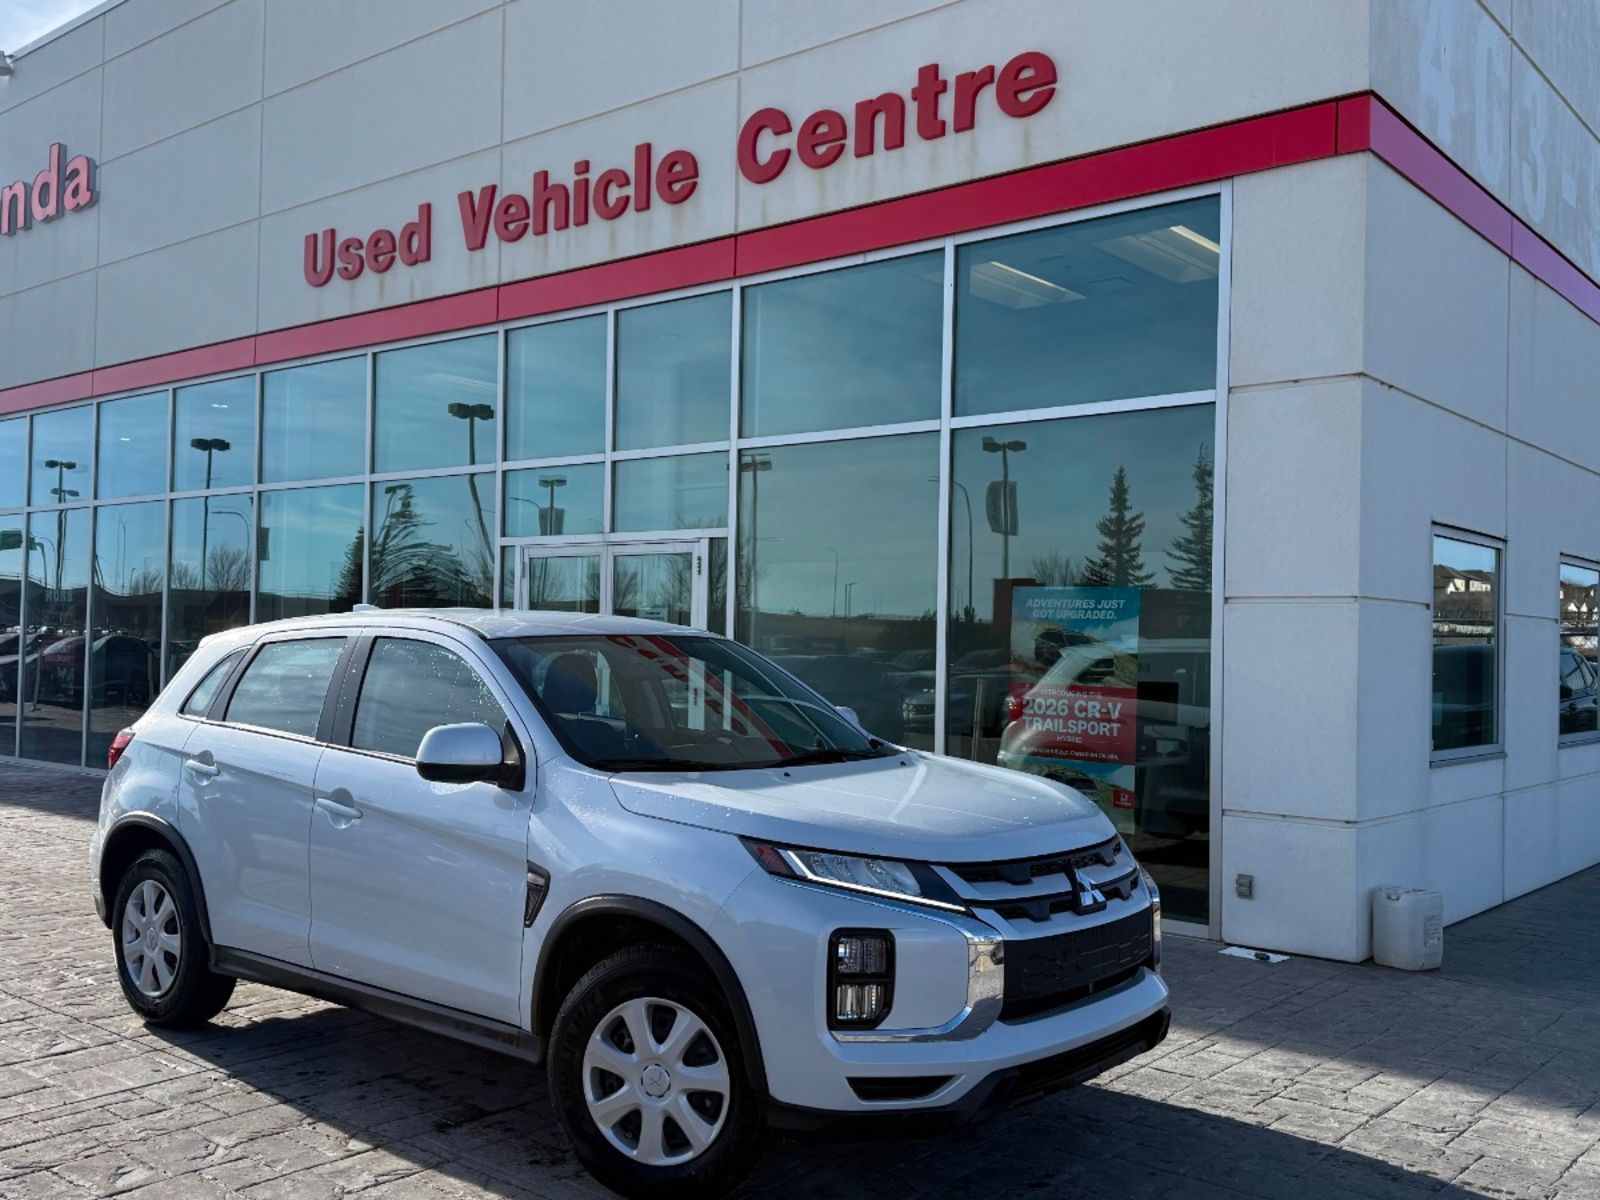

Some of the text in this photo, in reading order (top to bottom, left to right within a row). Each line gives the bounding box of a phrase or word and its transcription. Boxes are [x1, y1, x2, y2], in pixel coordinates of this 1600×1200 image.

[303, 51, 1058, 287] Used Vehicle Centre
[1025, 598, 1126, 609] ADVENTURES JUST
[1032, 609, 1117, 620] GOT UPGRADED.
[1023, 697, 1122, 720] 2026 CR-V
[1022, 716, 1121, 737] TRAILSPORT
